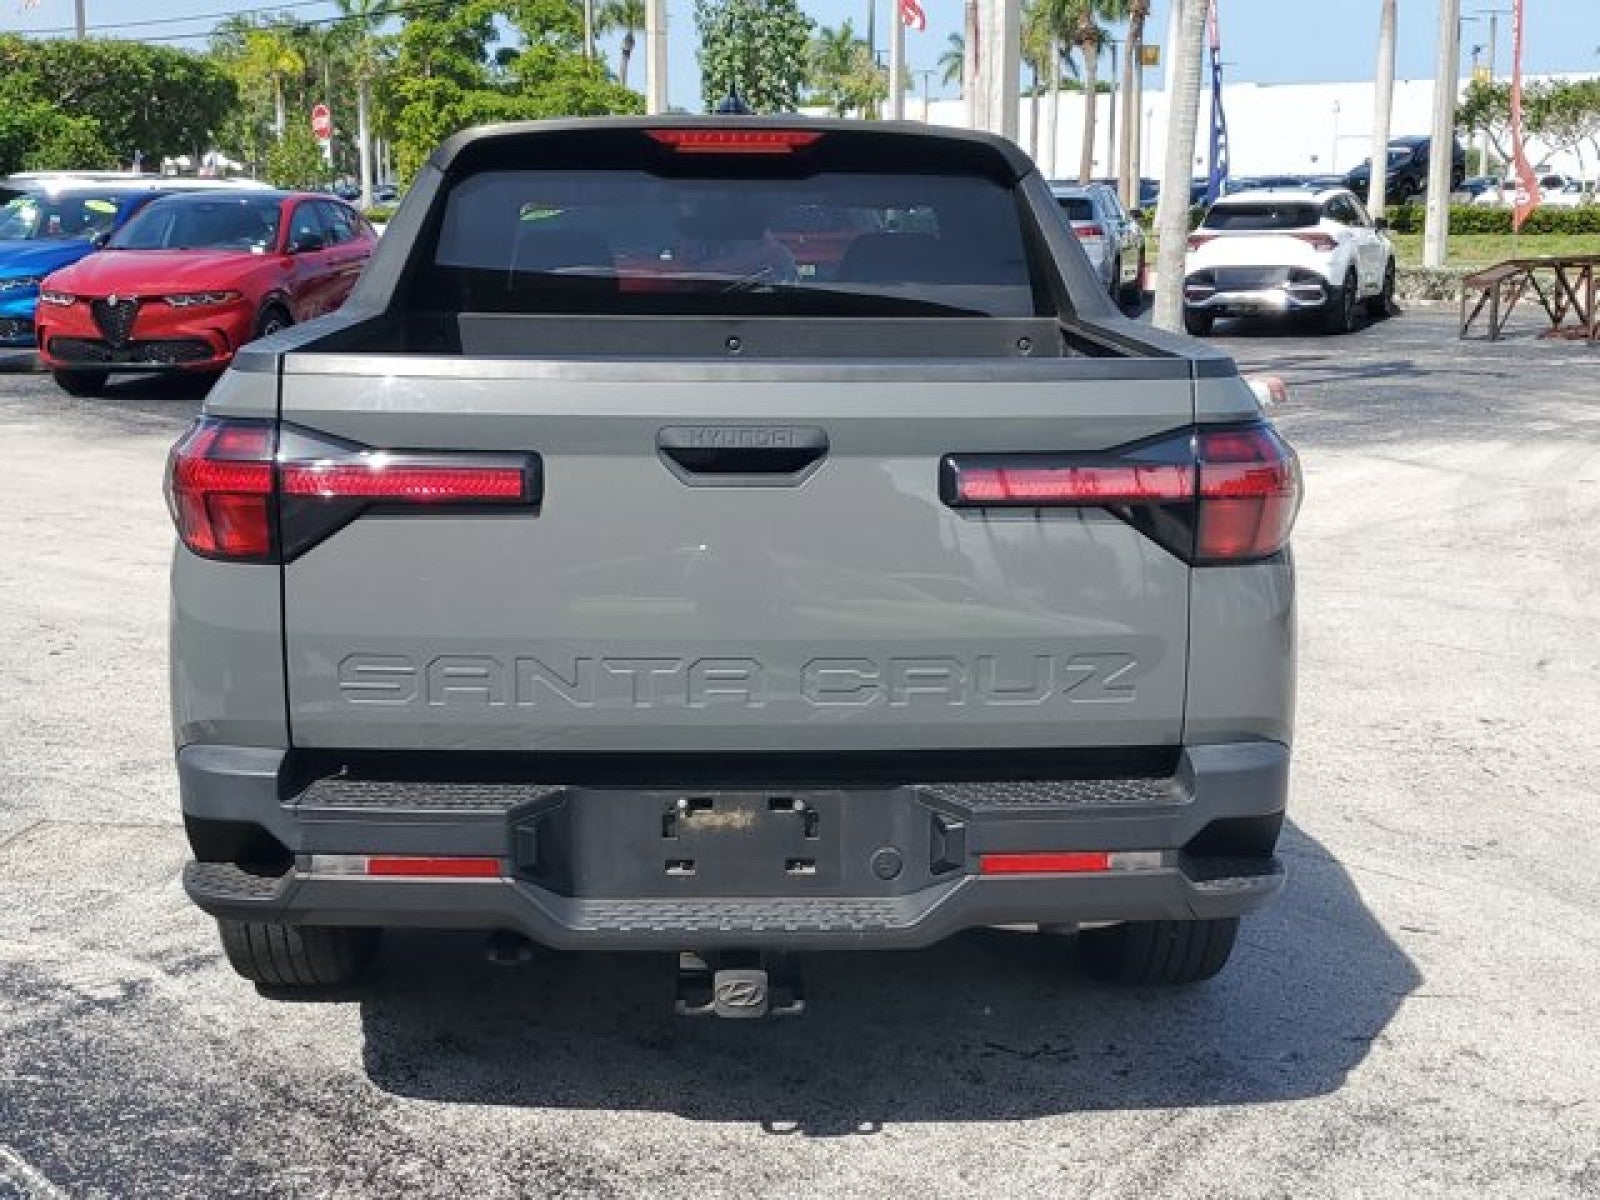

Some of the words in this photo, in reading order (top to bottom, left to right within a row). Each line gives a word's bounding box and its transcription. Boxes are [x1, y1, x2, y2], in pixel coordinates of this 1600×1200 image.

[688, 428, 796, 447] HYUNDAI
[337, 652, 765, 708] SANTA
[801, 652, 1138, 706] CRUZ
